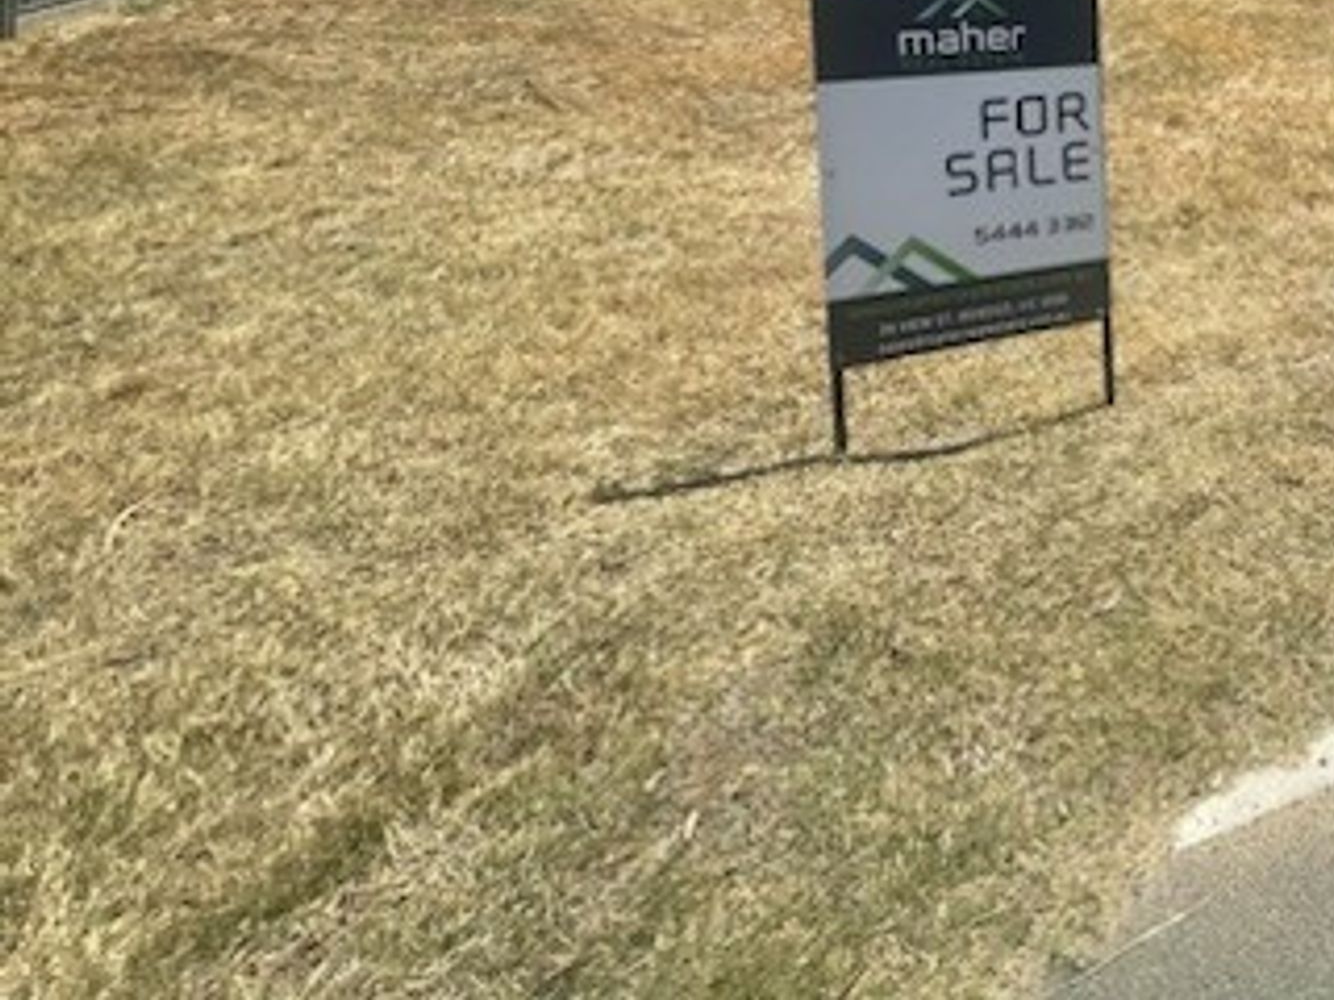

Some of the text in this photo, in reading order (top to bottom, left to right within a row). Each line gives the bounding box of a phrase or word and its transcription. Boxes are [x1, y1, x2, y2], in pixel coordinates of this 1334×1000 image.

[898, 21, 1026, 56] maher
[980, 91, 1090, 140] FOR
[945, 142, 1090, 197] SALE
